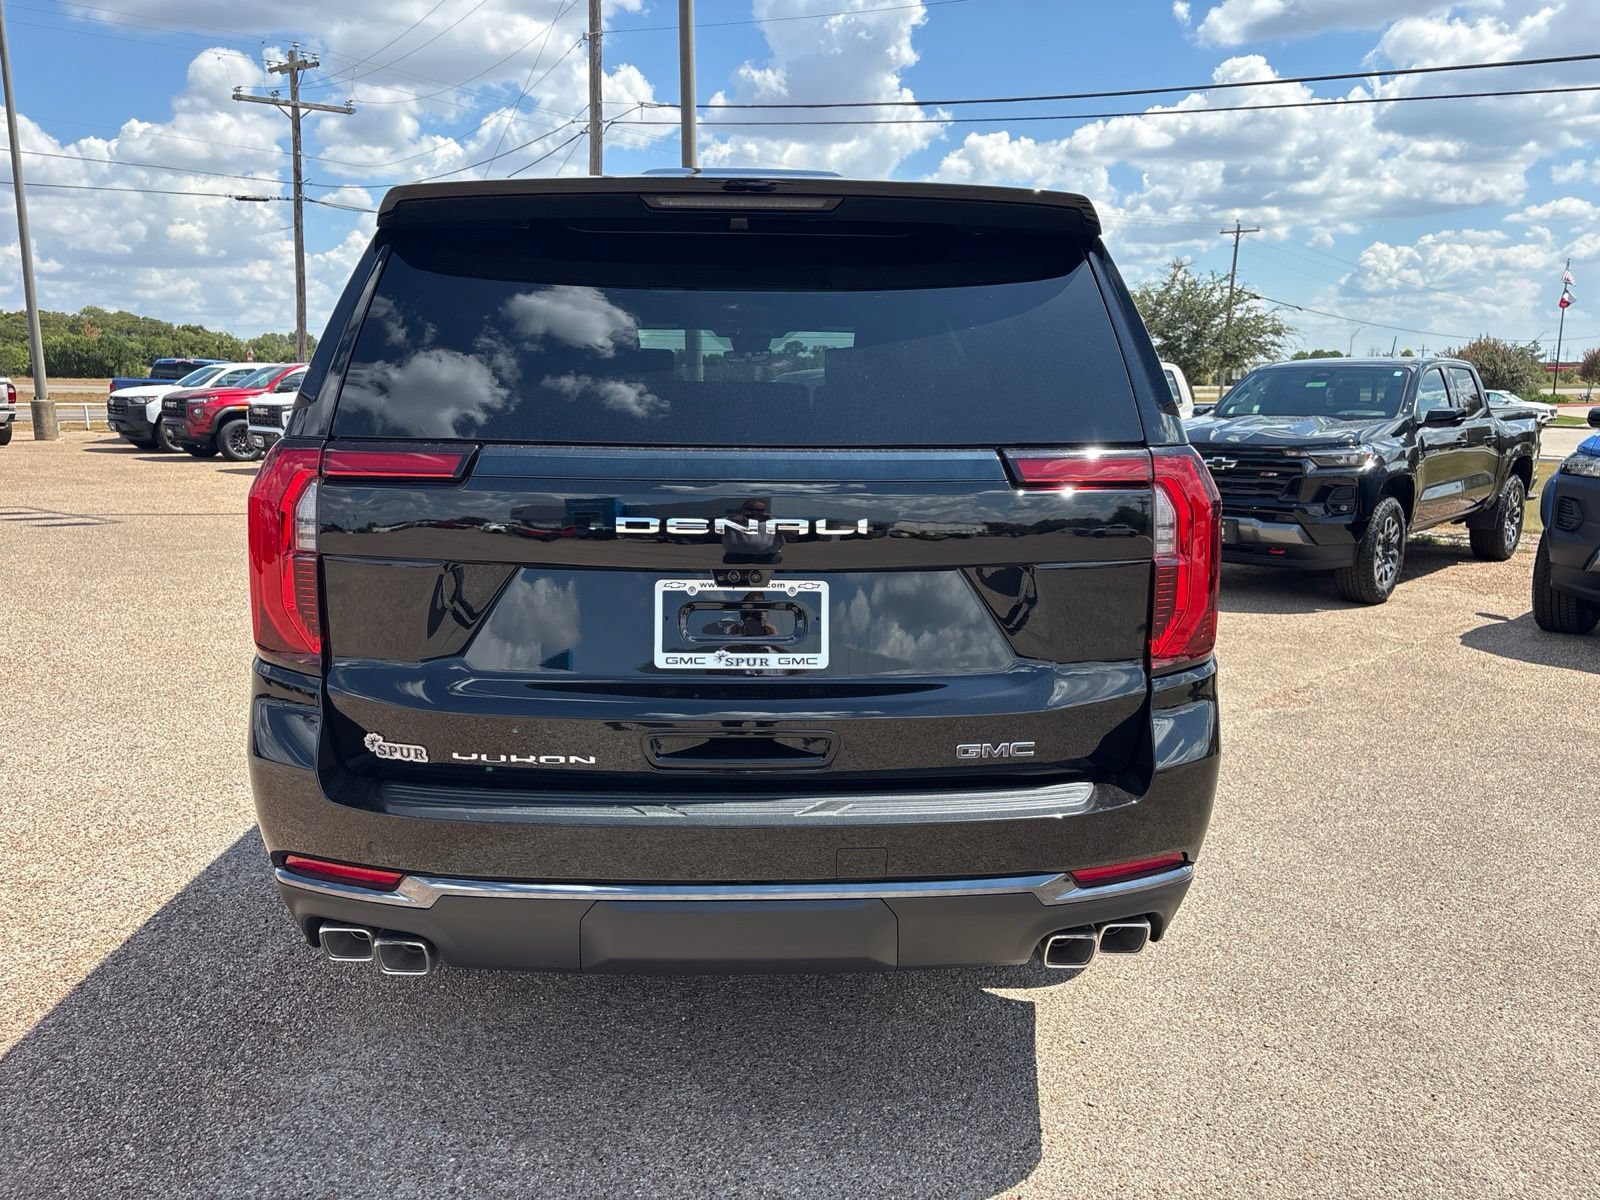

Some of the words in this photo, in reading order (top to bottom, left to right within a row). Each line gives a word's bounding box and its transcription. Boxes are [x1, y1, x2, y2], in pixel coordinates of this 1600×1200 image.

[615, 516, 868, 535] DENALI
[665, 656, 706, 666] GMC
[725, 657, 770, 668] SPUR
[778, 657, 818, 666] GMC
[377, 744, 425, 760] SPUR
[956, 741, 1036, 759] GMC
[452, 752, 596, 765] YUKON
